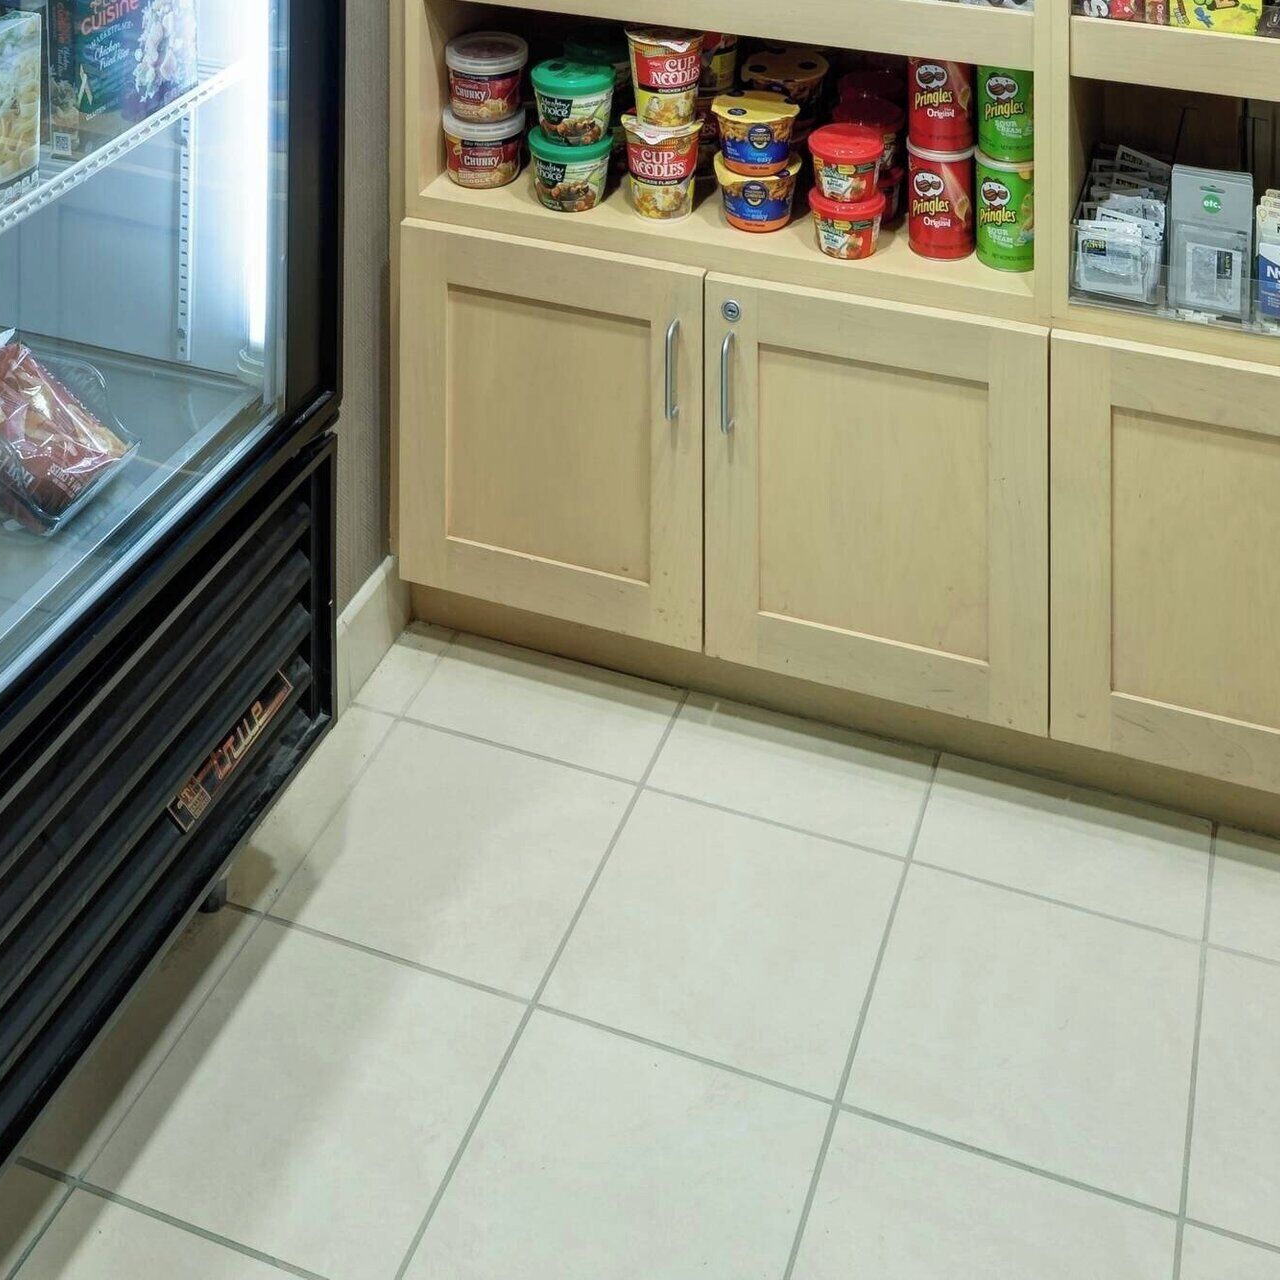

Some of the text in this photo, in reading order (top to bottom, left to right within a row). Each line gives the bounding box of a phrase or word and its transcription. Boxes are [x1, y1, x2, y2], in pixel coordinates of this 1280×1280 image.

[664, 57, 696, 70] CUP
[650, 70, 700, 86] NOODLES
[455, 86, 487, 101] CHUNKY
[914, 90, 953, 110] Pringles
[540, 106, 569, 118] Choice
[541, 99, 571, 111] Healthy
[985, 99, 1024, 118] Pringles
[464, 154, 500, 167] CHUNKY
[641, 151, 675, 164] CUP
[632, 161, 685, 177] NOODLES
[913, 196, 949, 216] Pringles
[1203, 199, 1221, 209] etc.
[979, 207, 1016, 226] Pringles
